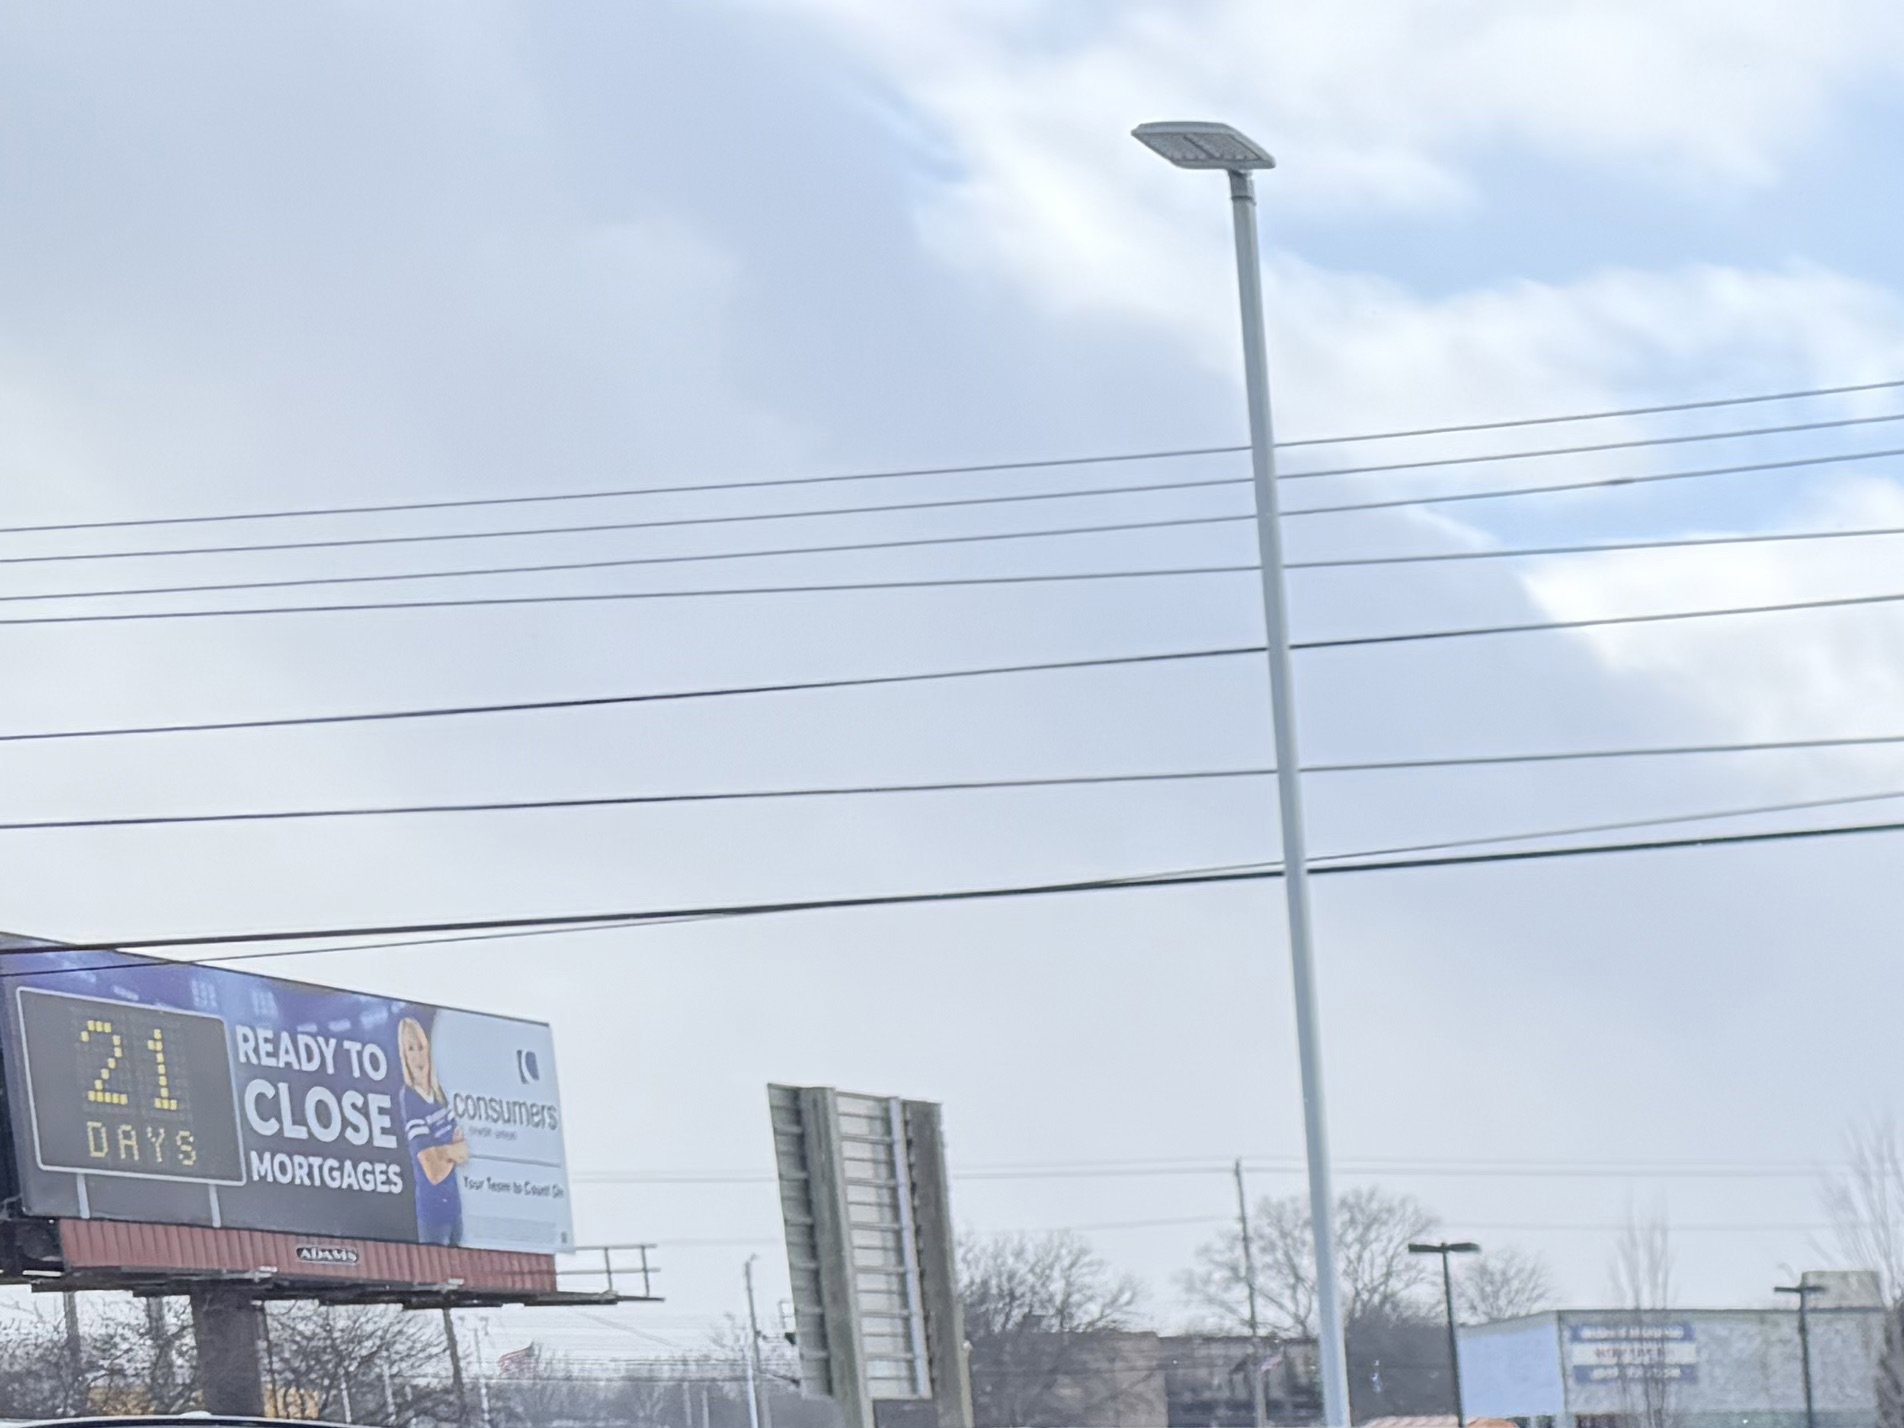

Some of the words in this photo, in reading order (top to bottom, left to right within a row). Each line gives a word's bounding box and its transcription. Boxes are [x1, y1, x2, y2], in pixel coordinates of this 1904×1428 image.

[80, 1018, 178, 1111] 21
[235, 1024, 337, 1076] READY
[342, 1041, 389, 1082] TO
[244, 1077, 398, 1149] CLOSE
[453, 1092, 558, 1131] consumers
[86, 1120, 198, 1167] DAYS
[250, 1149, 404, 1195] MORTGAGES
[299, 1246, 358, 1262] ADAMS
